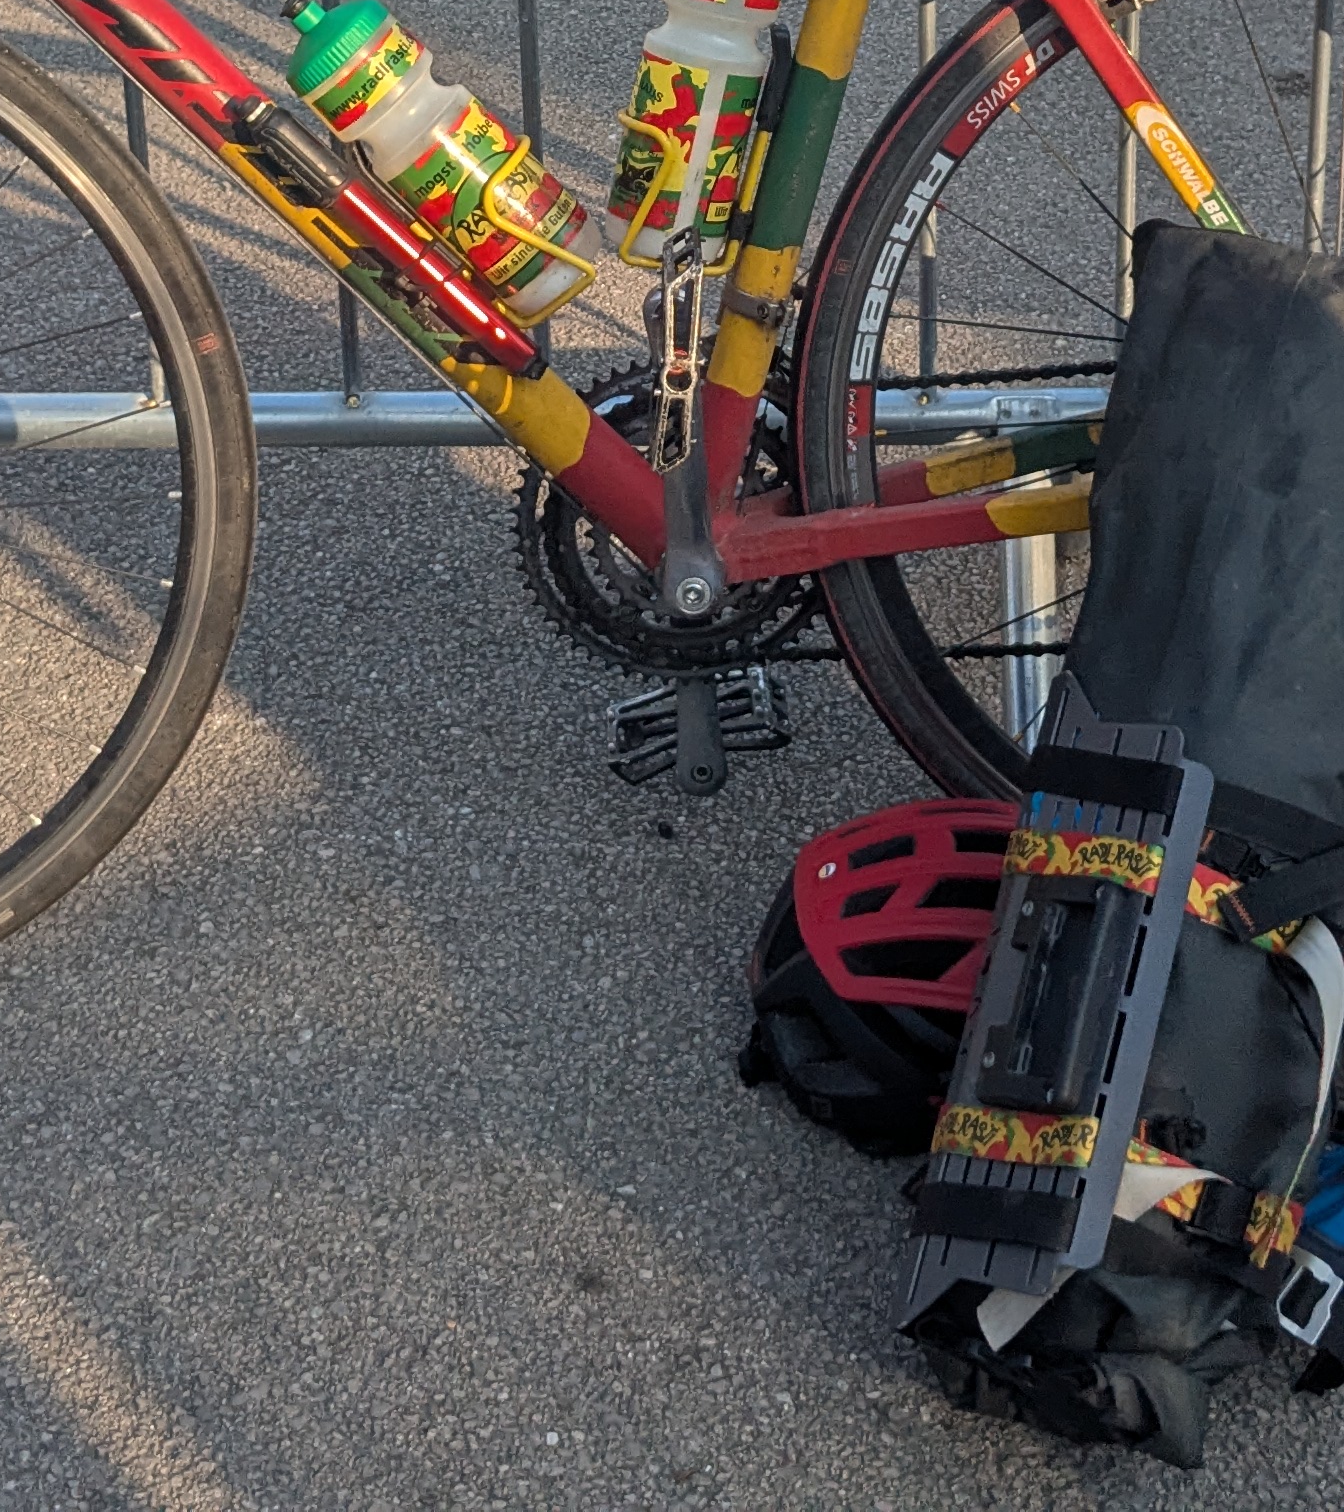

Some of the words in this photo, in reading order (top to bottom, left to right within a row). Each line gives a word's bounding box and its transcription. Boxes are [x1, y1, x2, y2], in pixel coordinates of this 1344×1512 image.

[1022, 39, 1055, 75] DT
[966, 70, 1020, 129] SWISS
[414, 159, 457, 199] mogst
[1151, 125, 1227, 227] SCHWALBE
[490, 261, 510, 281] Wir
